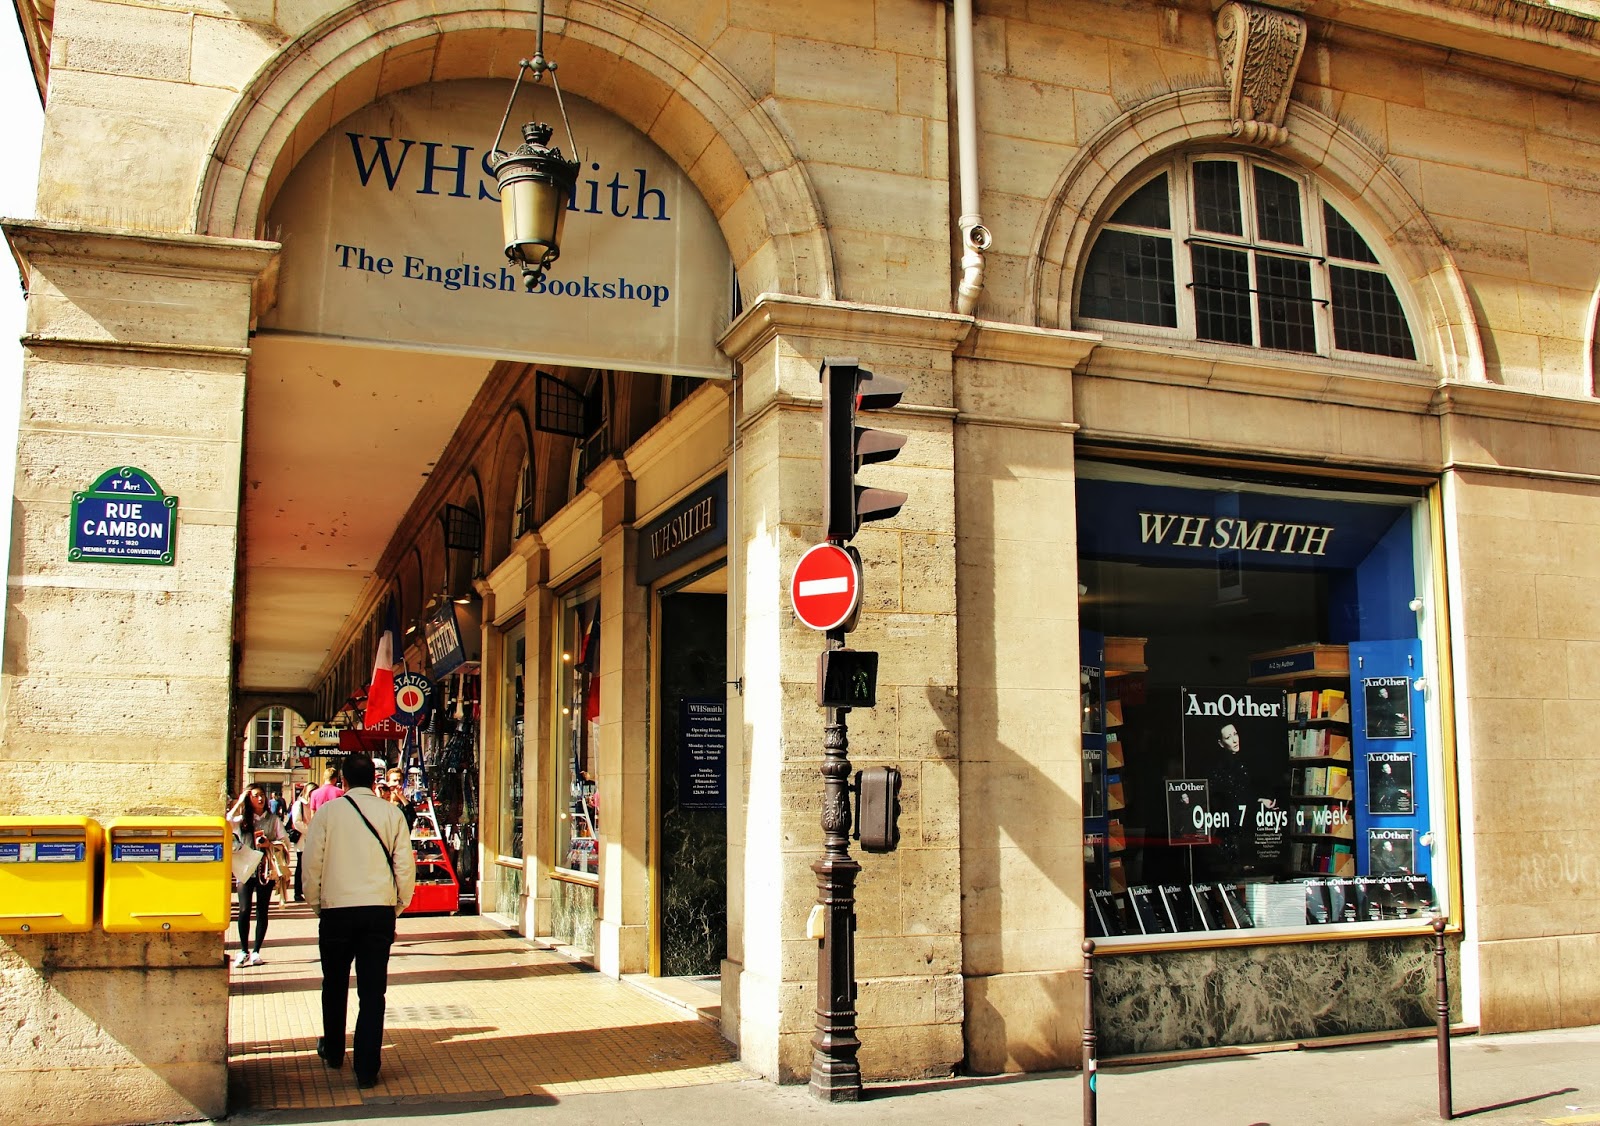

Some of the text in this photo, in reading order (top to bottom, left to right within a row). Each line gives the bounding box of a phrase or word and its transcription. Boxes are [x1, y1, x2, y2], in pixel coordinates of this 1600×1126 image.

[345, 131, 671, 221] WHSith
[335, 243, 670, 307] The English Bookshop
[105, 502, 142, 520] RUE
[83, 520, 163, 538] CAMBON
[394, 676, 431, 696] STATION
[1365, 678, 1406, 686] AnOther
[1185, 694, 1280, 717] AnOther
[1369, 753, 1410, 762] AnOther
[1168, 782, 1205, 792] AnOther
[1192, 805, 1230, 836] Open
[1238, 805, 1246, 827] 7
[1256, 803, 1288, 833] days
[1296, 810, 1305, 826] a
[1313, 801, 1348, 826] week
[1370, 830, 1410, 839] AnOther
